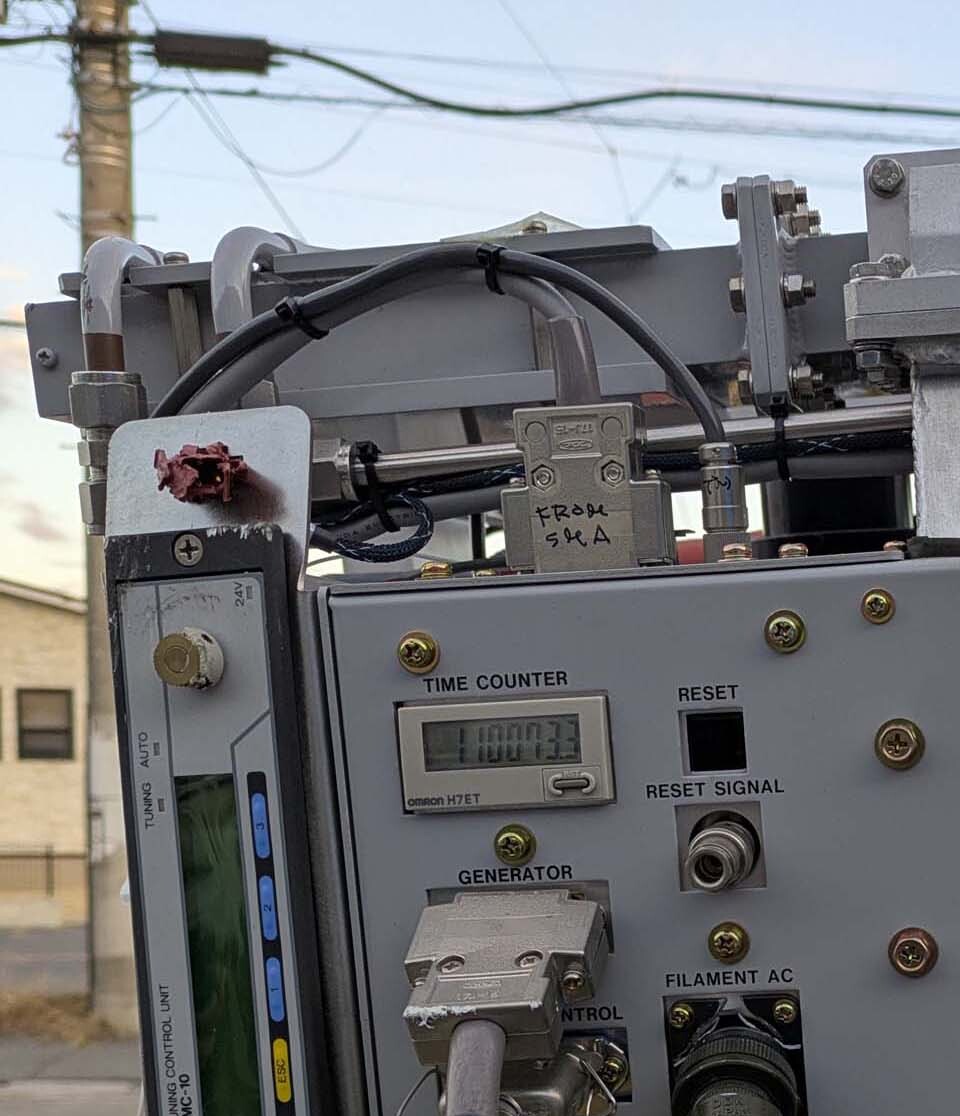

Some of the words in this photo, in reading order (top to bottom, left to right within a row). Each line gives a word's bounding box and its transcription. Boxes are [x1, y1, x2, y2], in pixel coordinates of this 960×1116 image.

[235, 581, 245, 607] 24V
[423, 676, 468, 693] TIME
[476, 671, 568, 690] COUNTER
[678, 685, 738, 702] RESET
[139, 731, 149, 769] AUTO
[447, 793, 480, 806] H7ET
[646, 782, 705, 798] RESET
[714, 779, 785, 796] SIGNAL
[142, 781, 155, 830] TUNING
[458, 865, 573, 884] GENERATOR
[665, 970, 758, 988] FILAMENT
[767, 968, 794, 984] AC
[158, 983, 170, 1013] UNIT
[560, 1005, 624, 1023] NTROL
[161, 1015, 175, 1078] CONTROL
[277, 1059, 288, 1084] ESC
